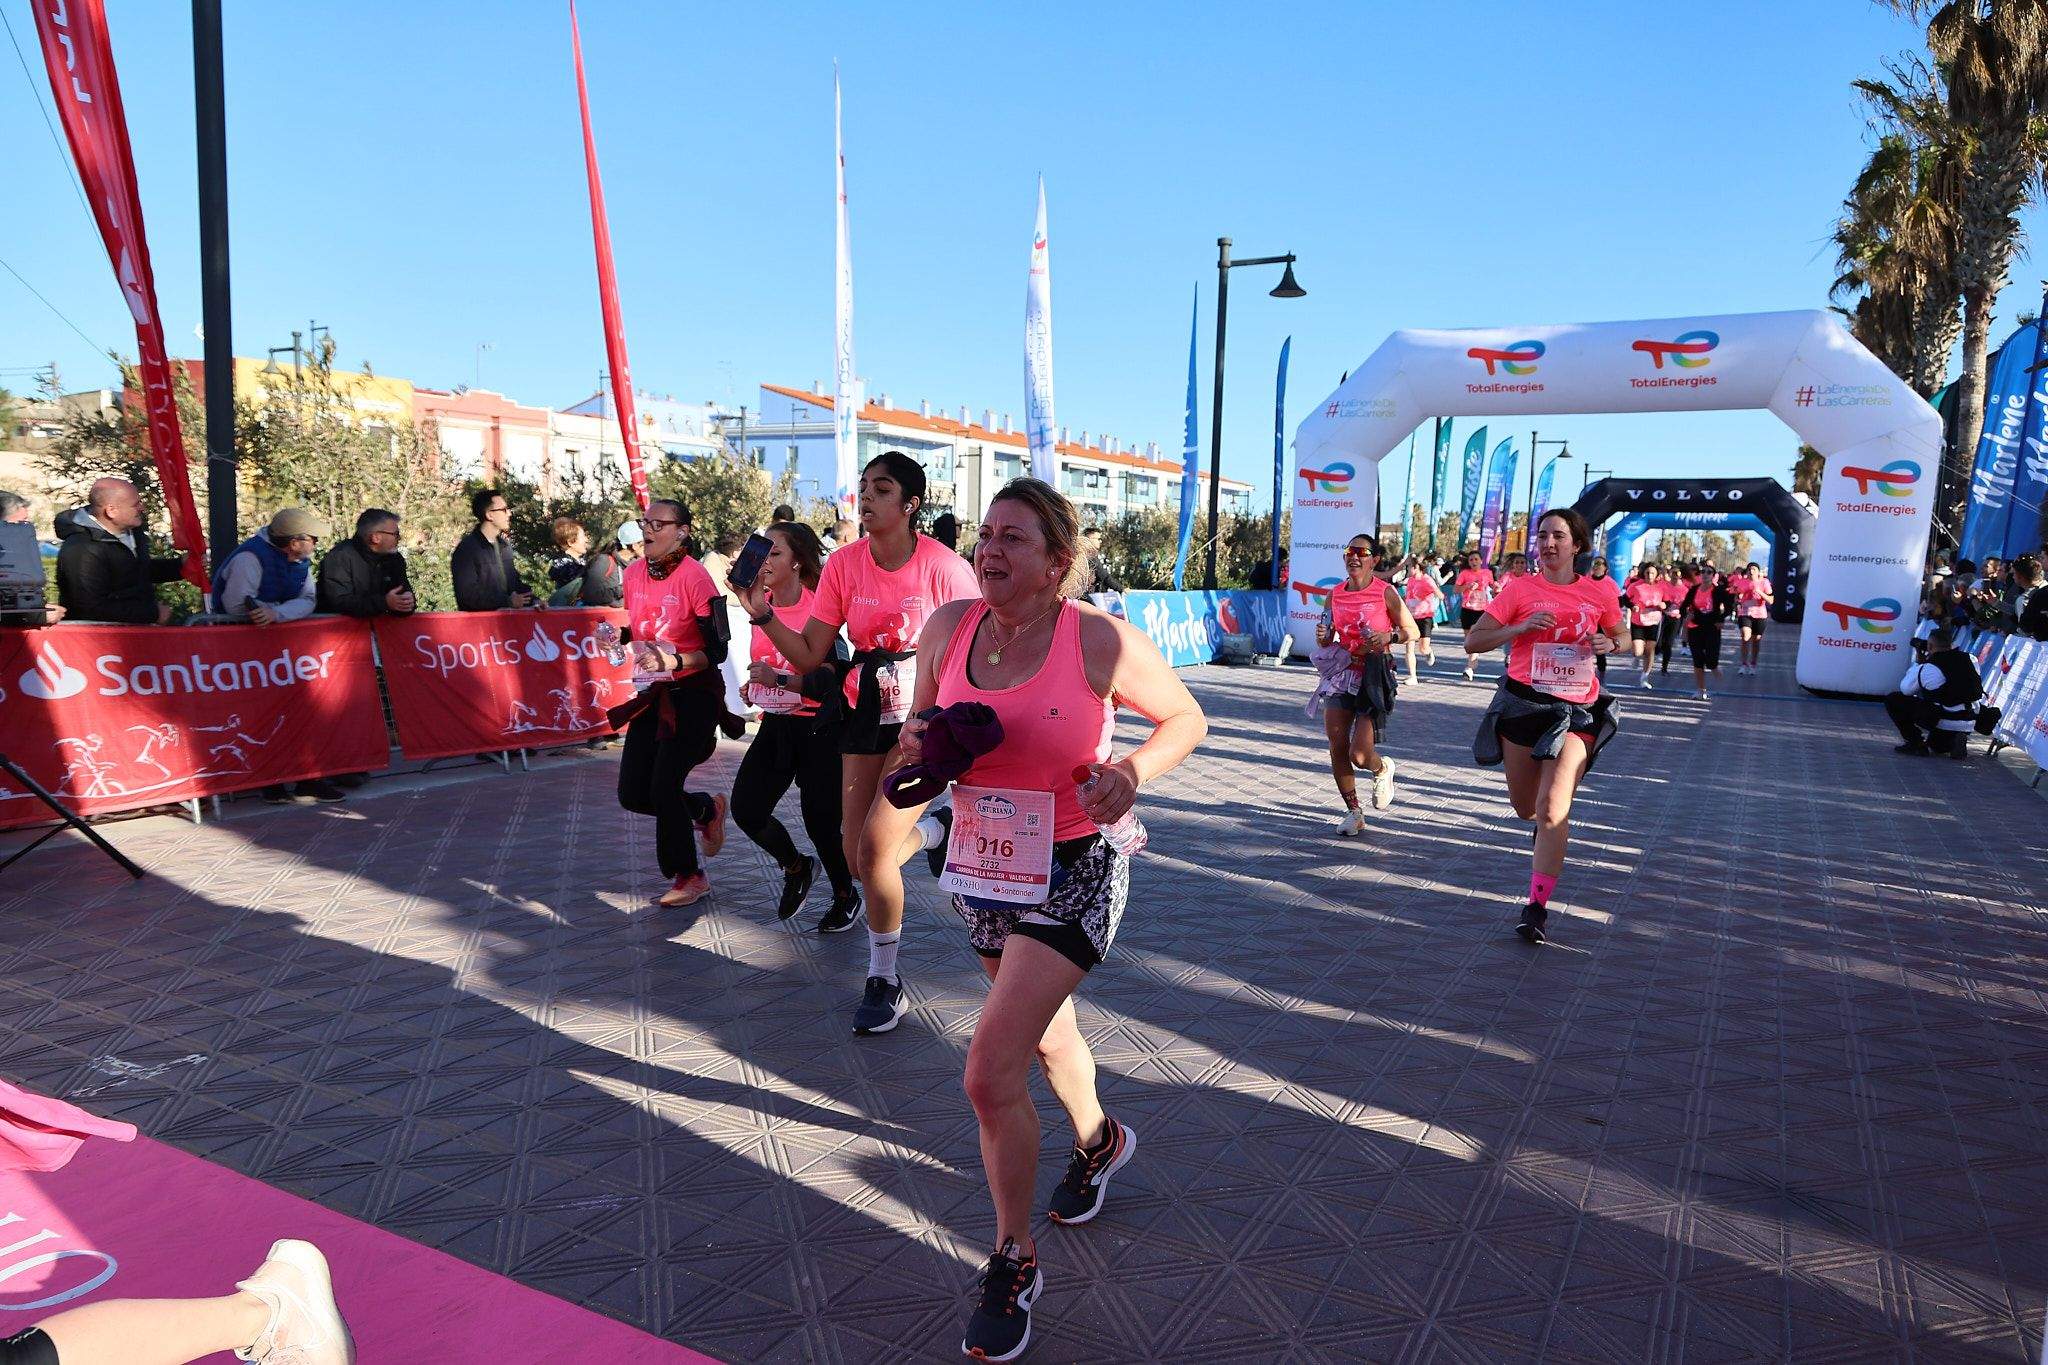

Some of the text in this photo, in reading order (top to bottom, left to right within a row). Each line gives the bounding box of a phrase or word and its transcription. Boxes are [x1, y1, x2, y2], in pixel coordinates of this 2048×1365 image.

[1466, 383, 1545, 395] TotalEnergies
[1630, 375, 1717, 389] TotalEnergies
[1972, 394, 2026, 508] Marlene
[1626, 489, 1744, 501] VOLVO
[1297, 498, 1354, 509] TotalEnergies
[1836, 502, 1917, 516] TotalEnergies
[1828, 554, 1909, 565] totalenergies.es
[1785, 533, 1800, 612] VOLVO
[1290, 611, 1322, 620] TotalEne
[1817, 636, 1898, 652] TotalEnergies
[415, 635, 521, 678] Sports
[95, 649, 335, 696] Santander
[1553, 666, 1575, 676] 016
[976, 836, 1014, 857] 016
[980, 859, 1000, 870] 2732
[951, 877, 1035, 897] OYSHO Santander
